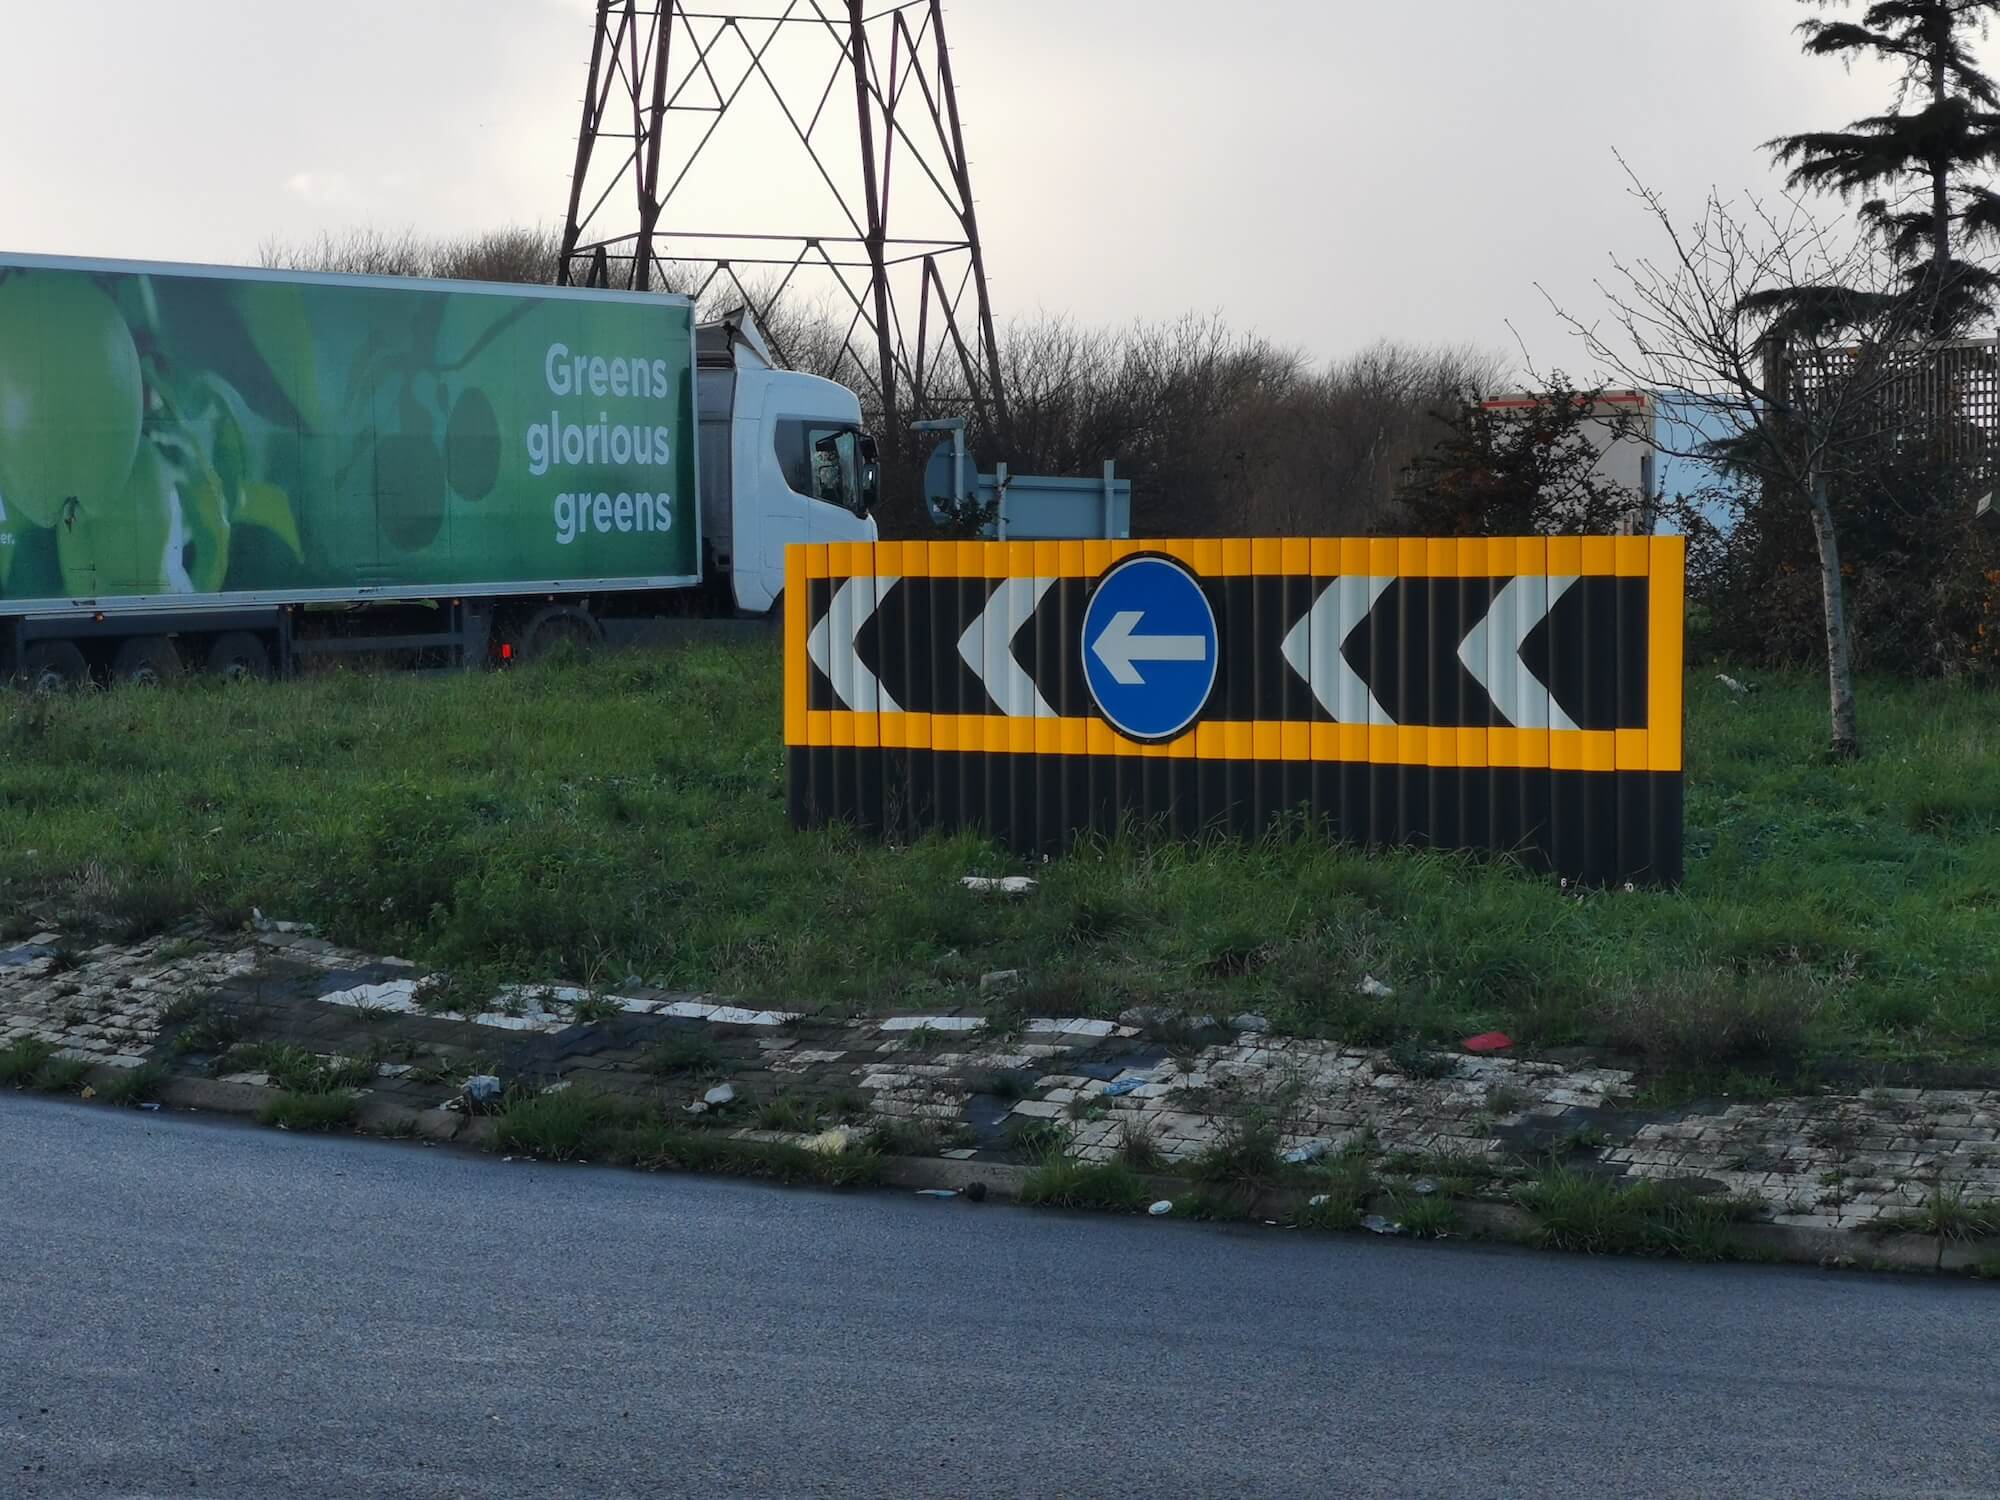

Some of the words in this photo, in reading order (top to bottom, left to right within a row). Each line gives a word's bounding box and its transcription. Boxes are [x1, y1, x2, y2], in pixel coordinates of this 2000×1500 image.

[545, 342, 668, 399] Greens
[526, 410, 670, 476] glorious
[554, 492, 672, 545] greens
